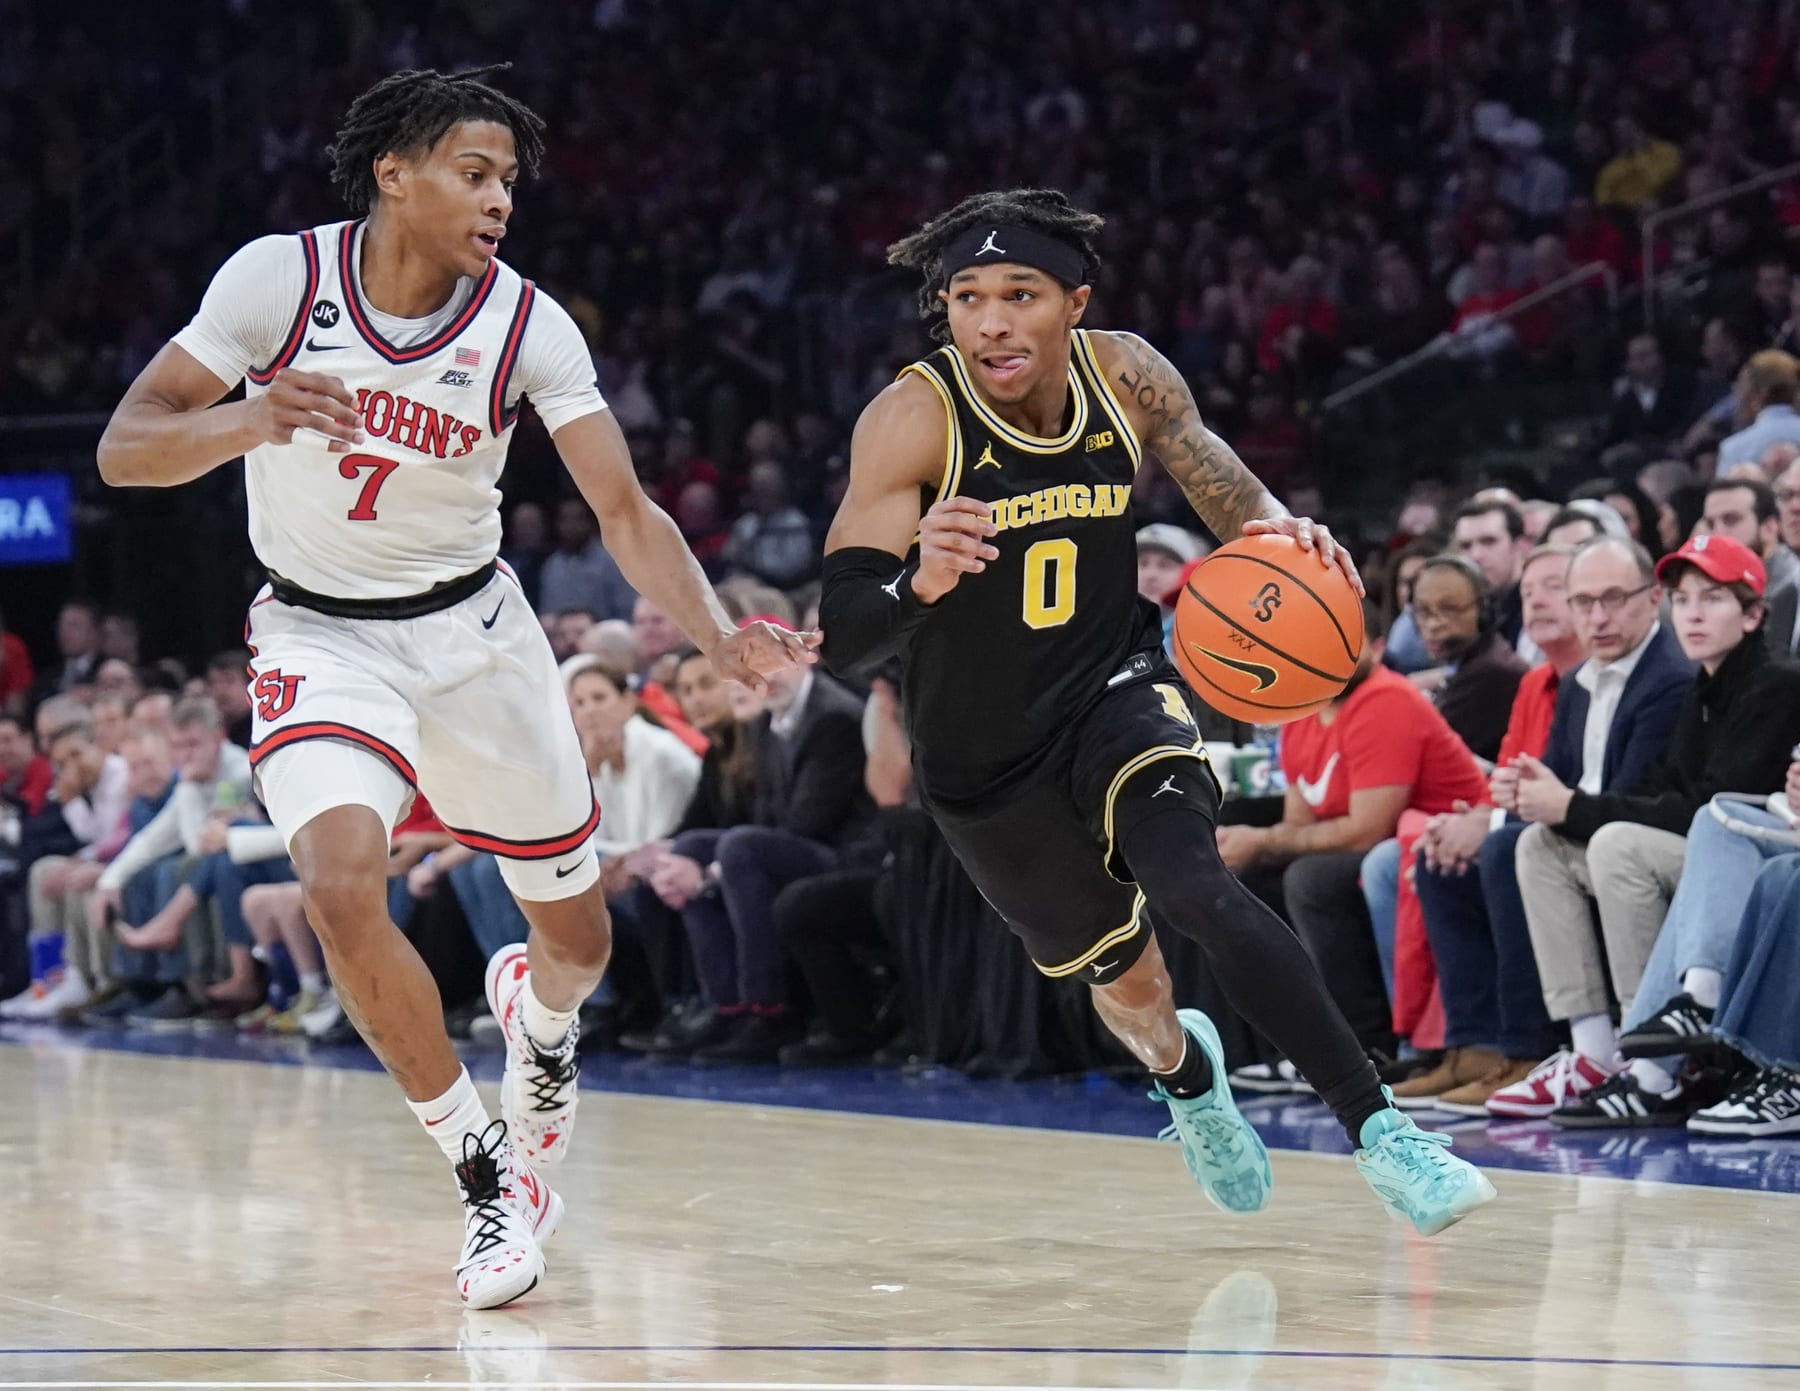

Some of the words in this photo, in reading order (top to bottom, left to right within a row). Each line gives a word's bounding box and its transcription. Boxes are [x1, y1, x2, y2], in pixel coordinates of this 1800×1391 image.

[314, 304, 337, 323] JK
[440, 376, 474, 387] EAST
[445, 369, 470, 379] BIG
[338, 453, 400, 521] 7
[1022, 537, 1078, 630] 0
[254, 667, 306, 722] SJ
